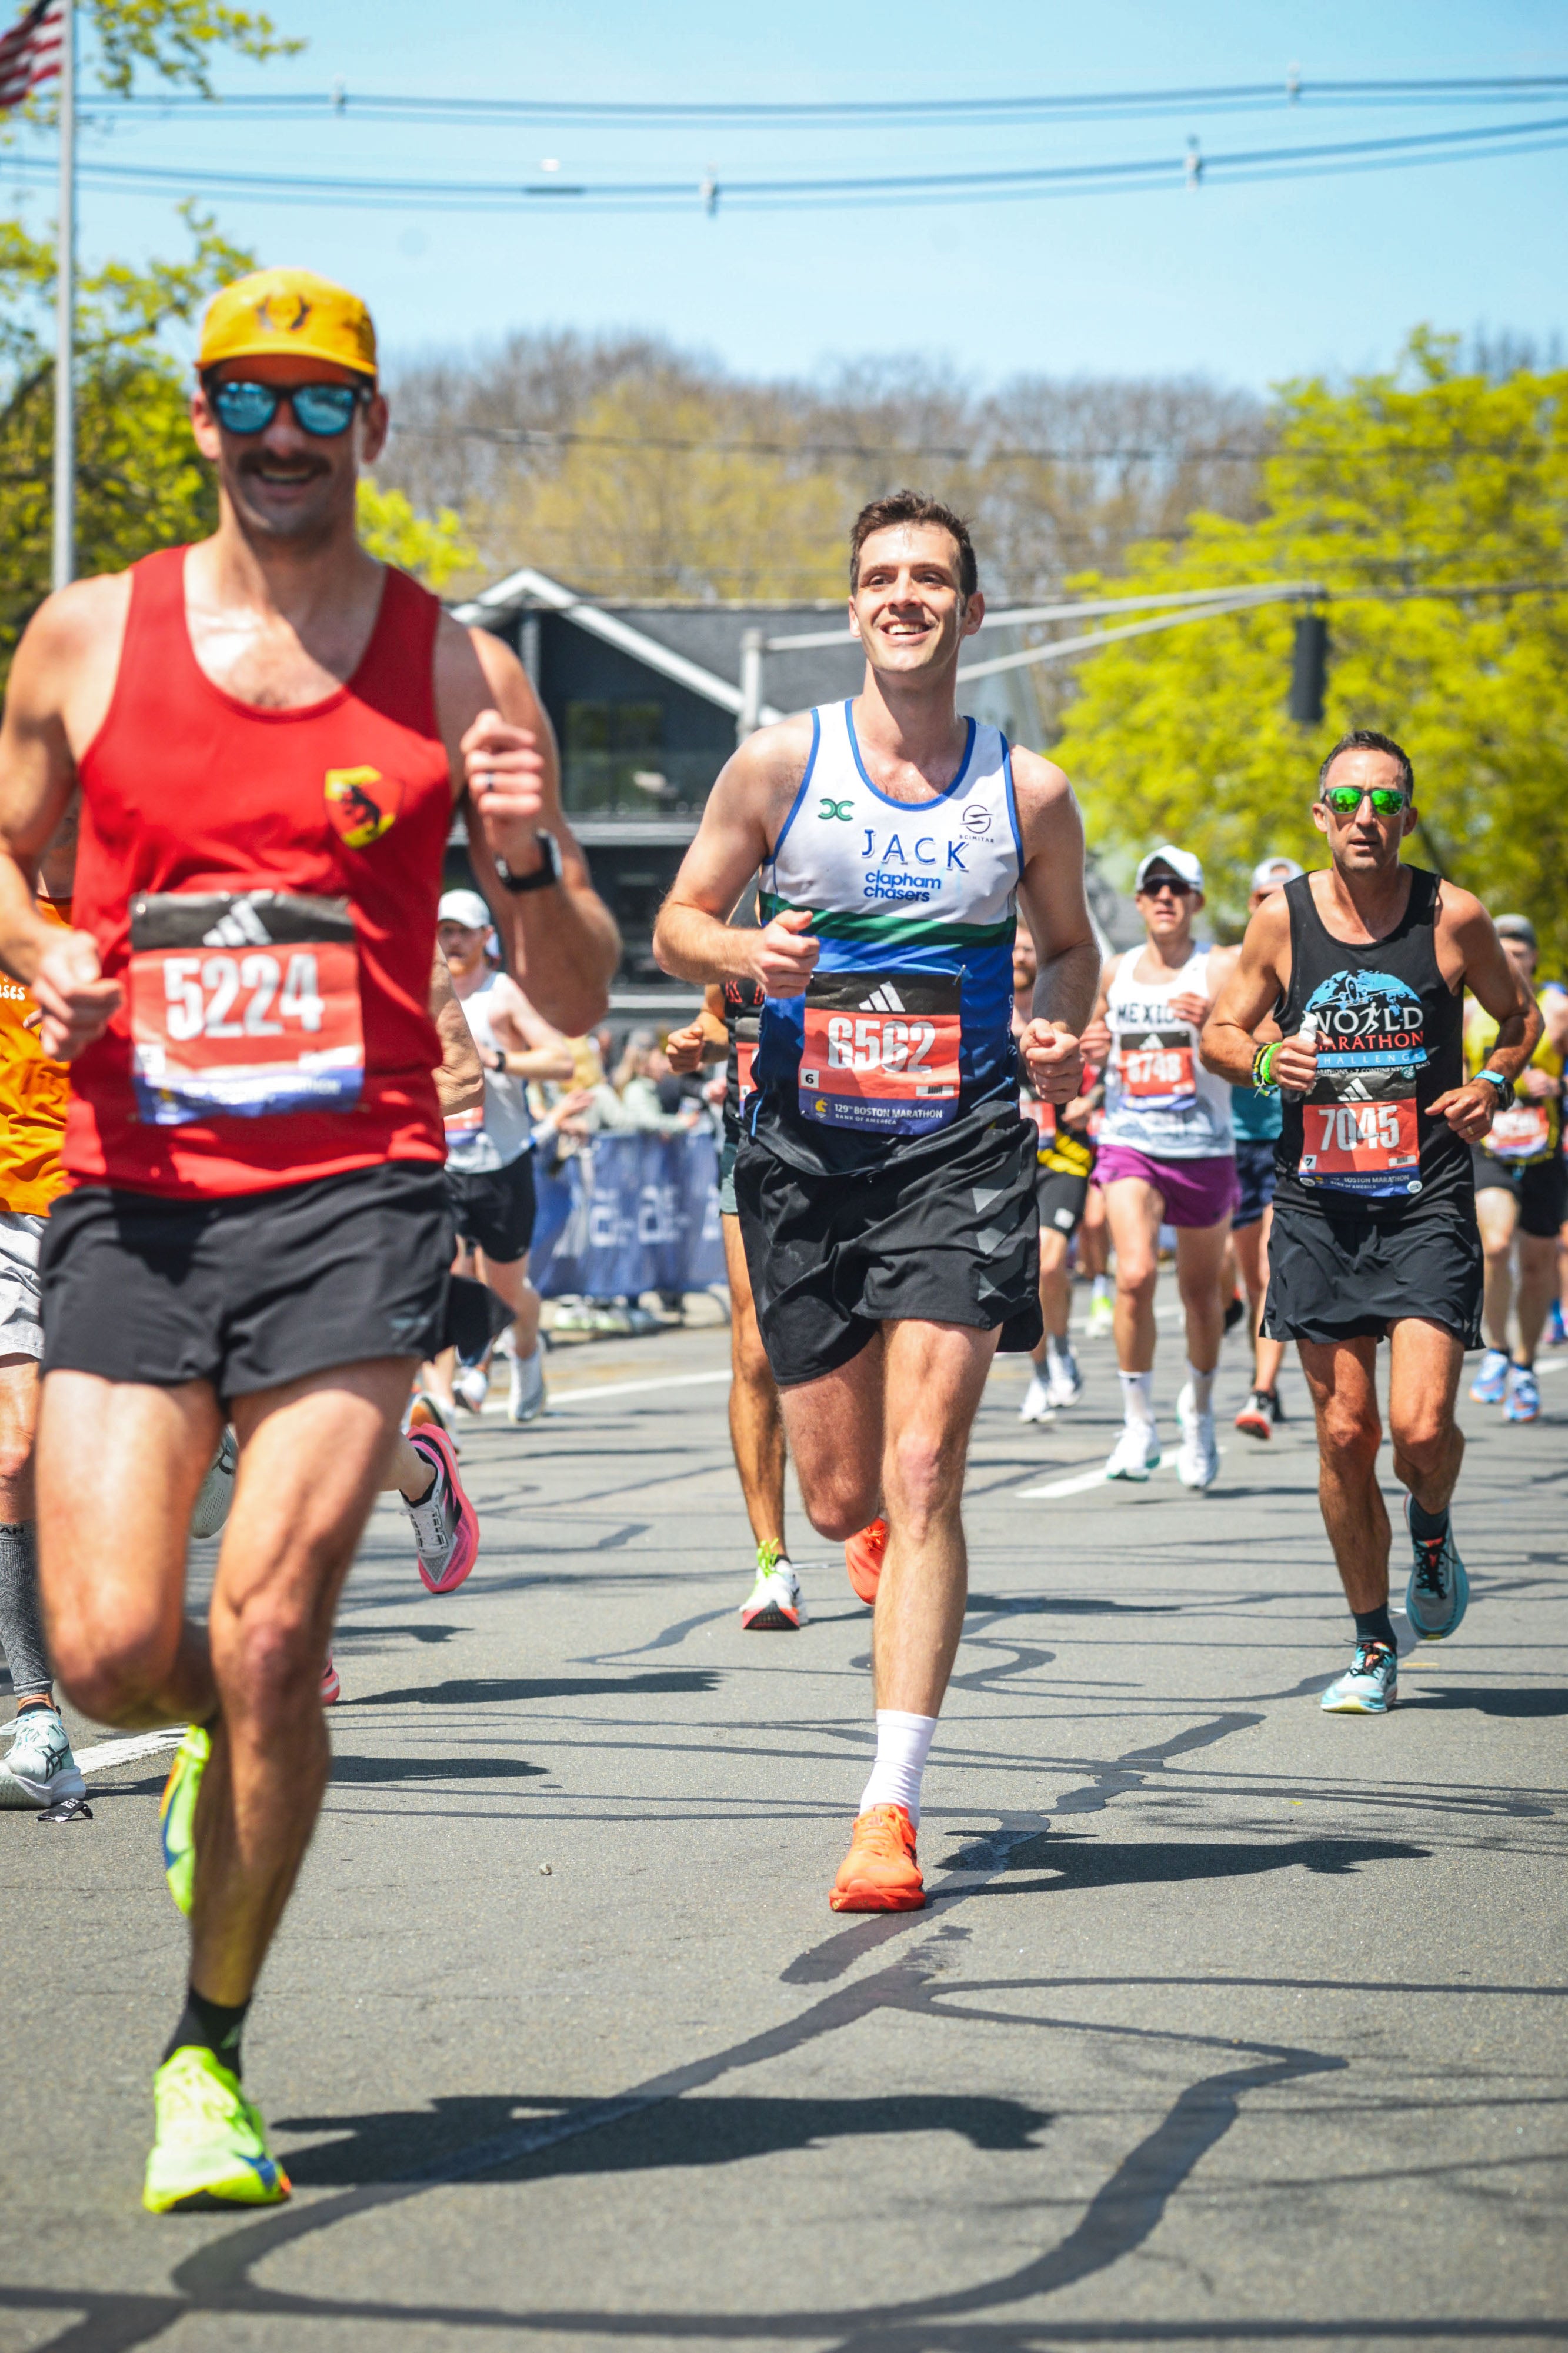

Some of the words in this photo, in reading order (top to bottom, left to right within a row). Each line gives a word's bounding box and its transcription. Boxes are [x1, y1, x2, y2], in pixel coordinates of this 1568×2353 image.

[959, 834, 994, 844] SCIMITAR
[861, 829, 968, 871] JACK
[865, 869, 942, 889] clapham
[863, 884, 930, 902] chasers
[0, 984, 25, 1001] SES
[162, 954, 325, 1040] 5224
[828, 1016, 936, 1074] 6562
[1323, 1054, 1420, 1065] HALLENGE
[805, 1074, 815, 1084] 6
[854, 1106, 890, 1117] BOSTON
[892, 1109, 943, 1118] MARATHON
[1318, 1105, 1400, 1151] 7045
[1306, 1158, 1313, 1166] 7
[1372, 1175, 1410, 1184] MARATHON
